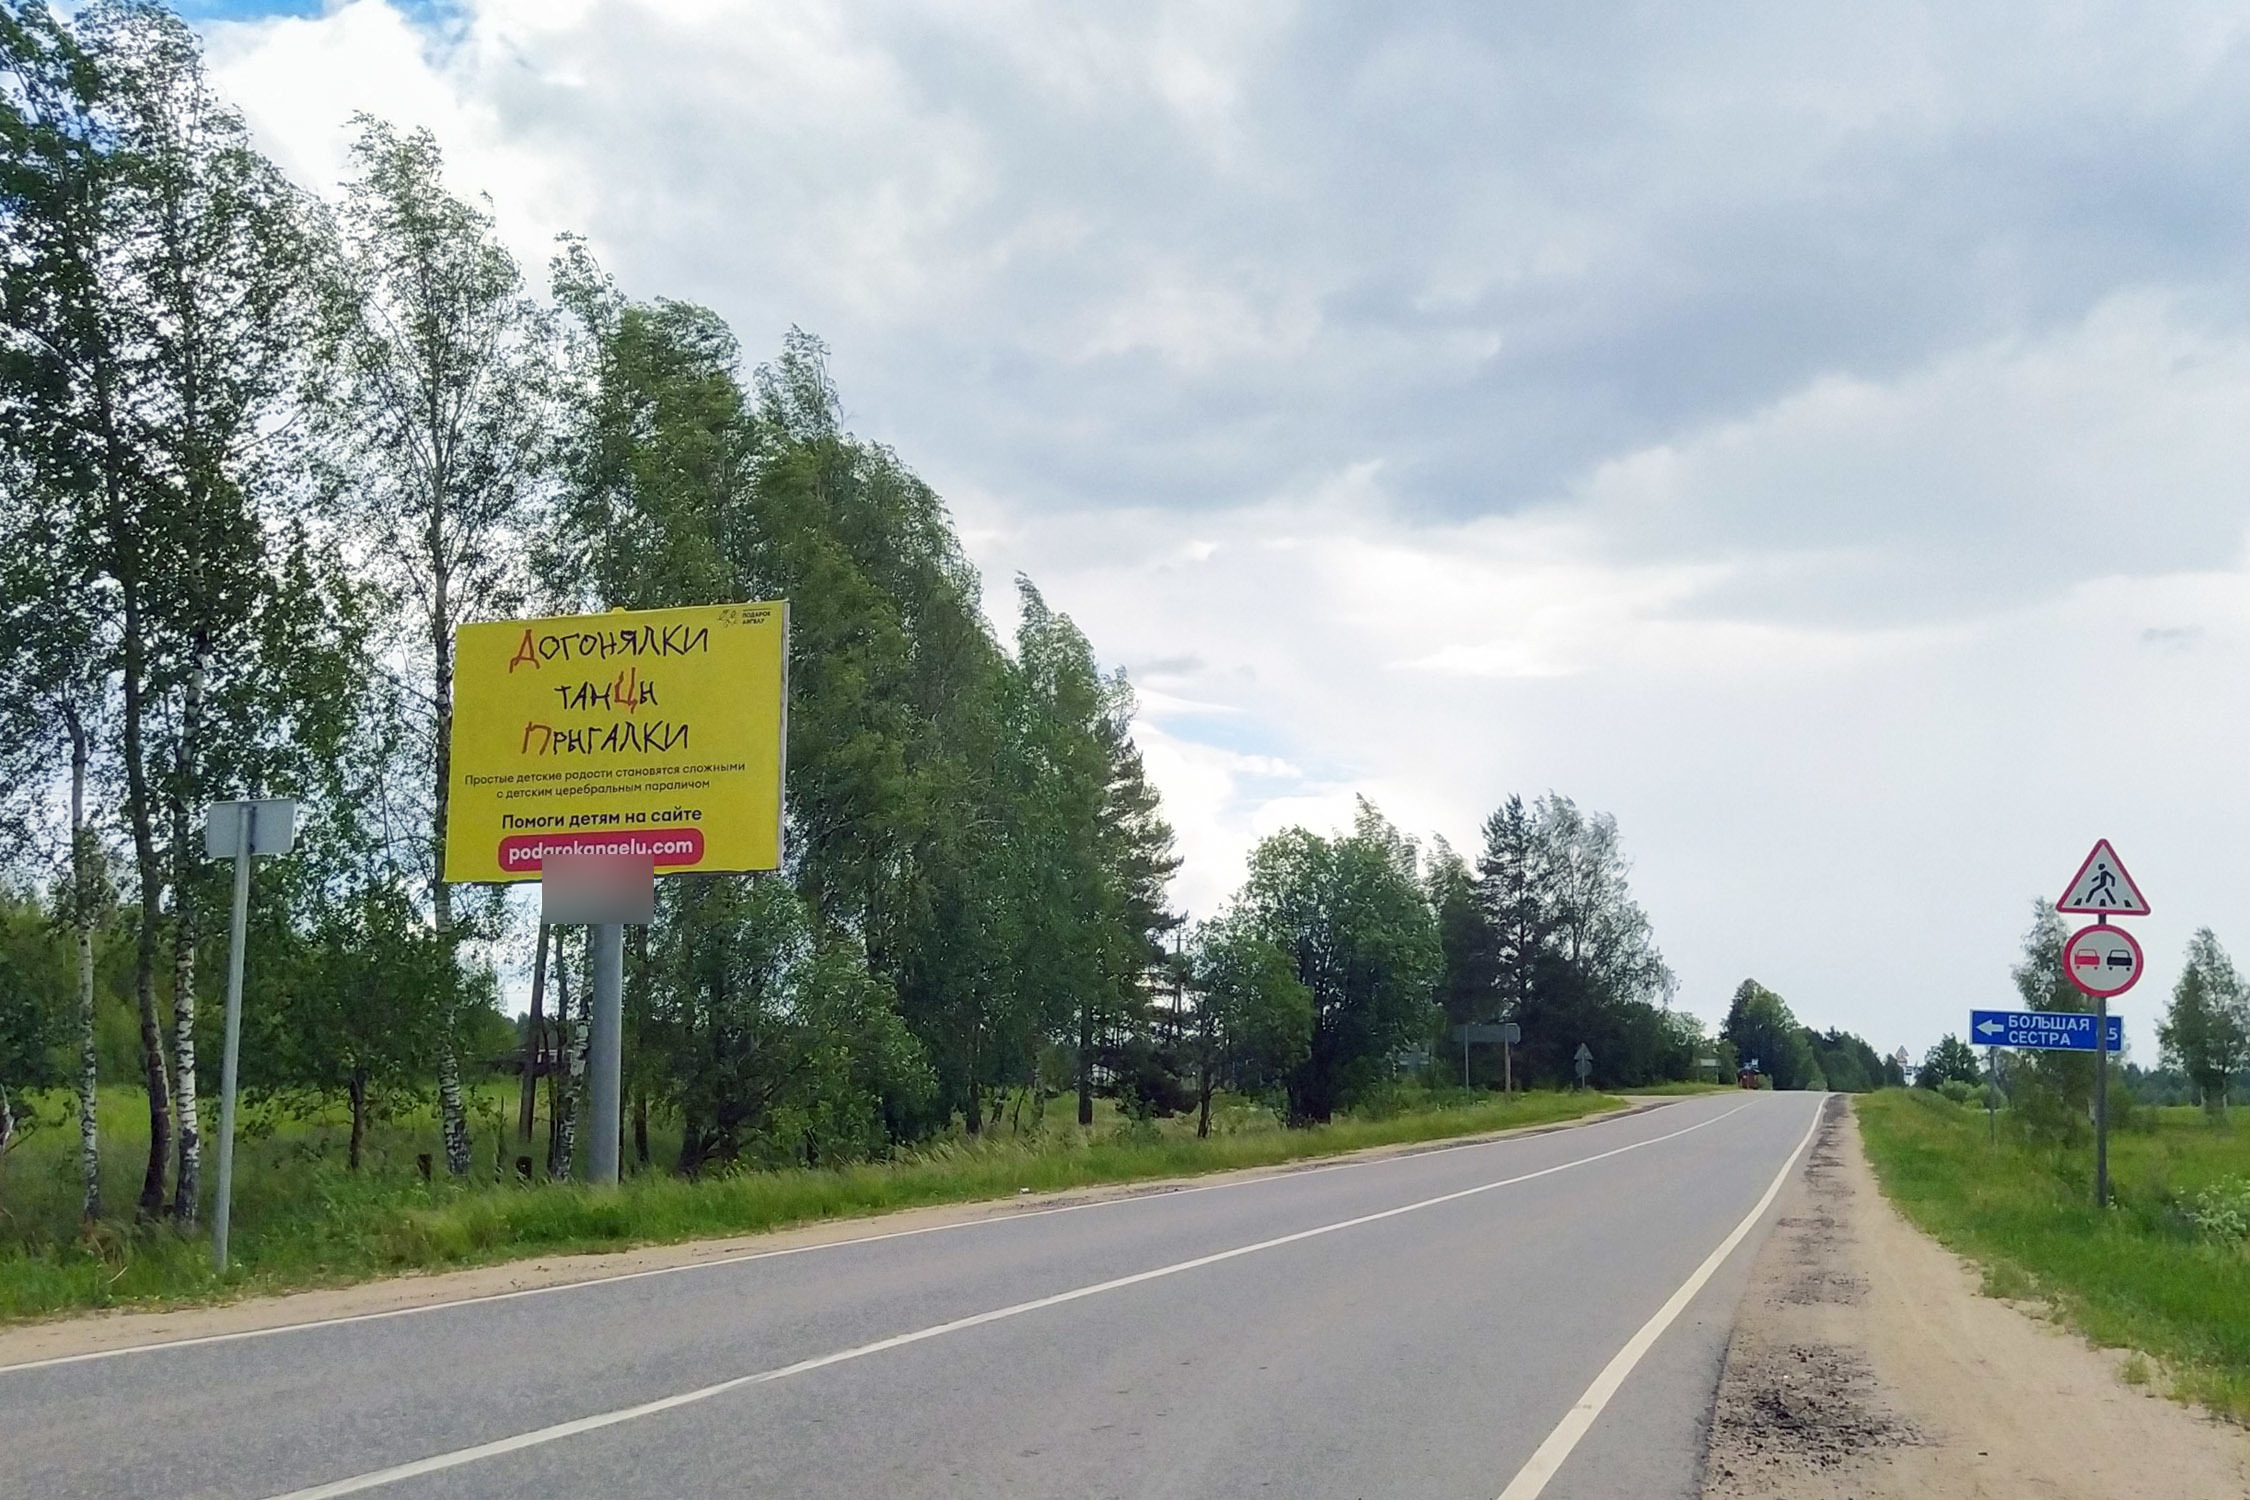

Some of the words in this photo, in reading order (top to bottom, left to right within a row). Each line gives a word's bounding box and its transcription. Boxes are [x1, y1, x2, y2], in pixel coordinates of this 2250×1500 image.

[465, 774, 514, 786] Простые
[516, 771, 562, 783] детские
[565, 769, 613, 781] радости
[615, 766, 680, 778] становятся
[682, 763, 746, 773] сложными
[496, 790, 504, 799] с
[505, 787, 553, 799] детским
[555, 782, 642, 797] церебральным
[645, 779, 710, 791] параличом
[502, 814, 565, 829] Помоги
[569, 812, 620, 827] детям
[625, 811, 646, 824] на
[651, 806, 703, 822] сайте
[2008, 1014, 2090, 1031] БОЛЬШАЯ
[2008, 1030, 2071, 1046] СЕСТРА
